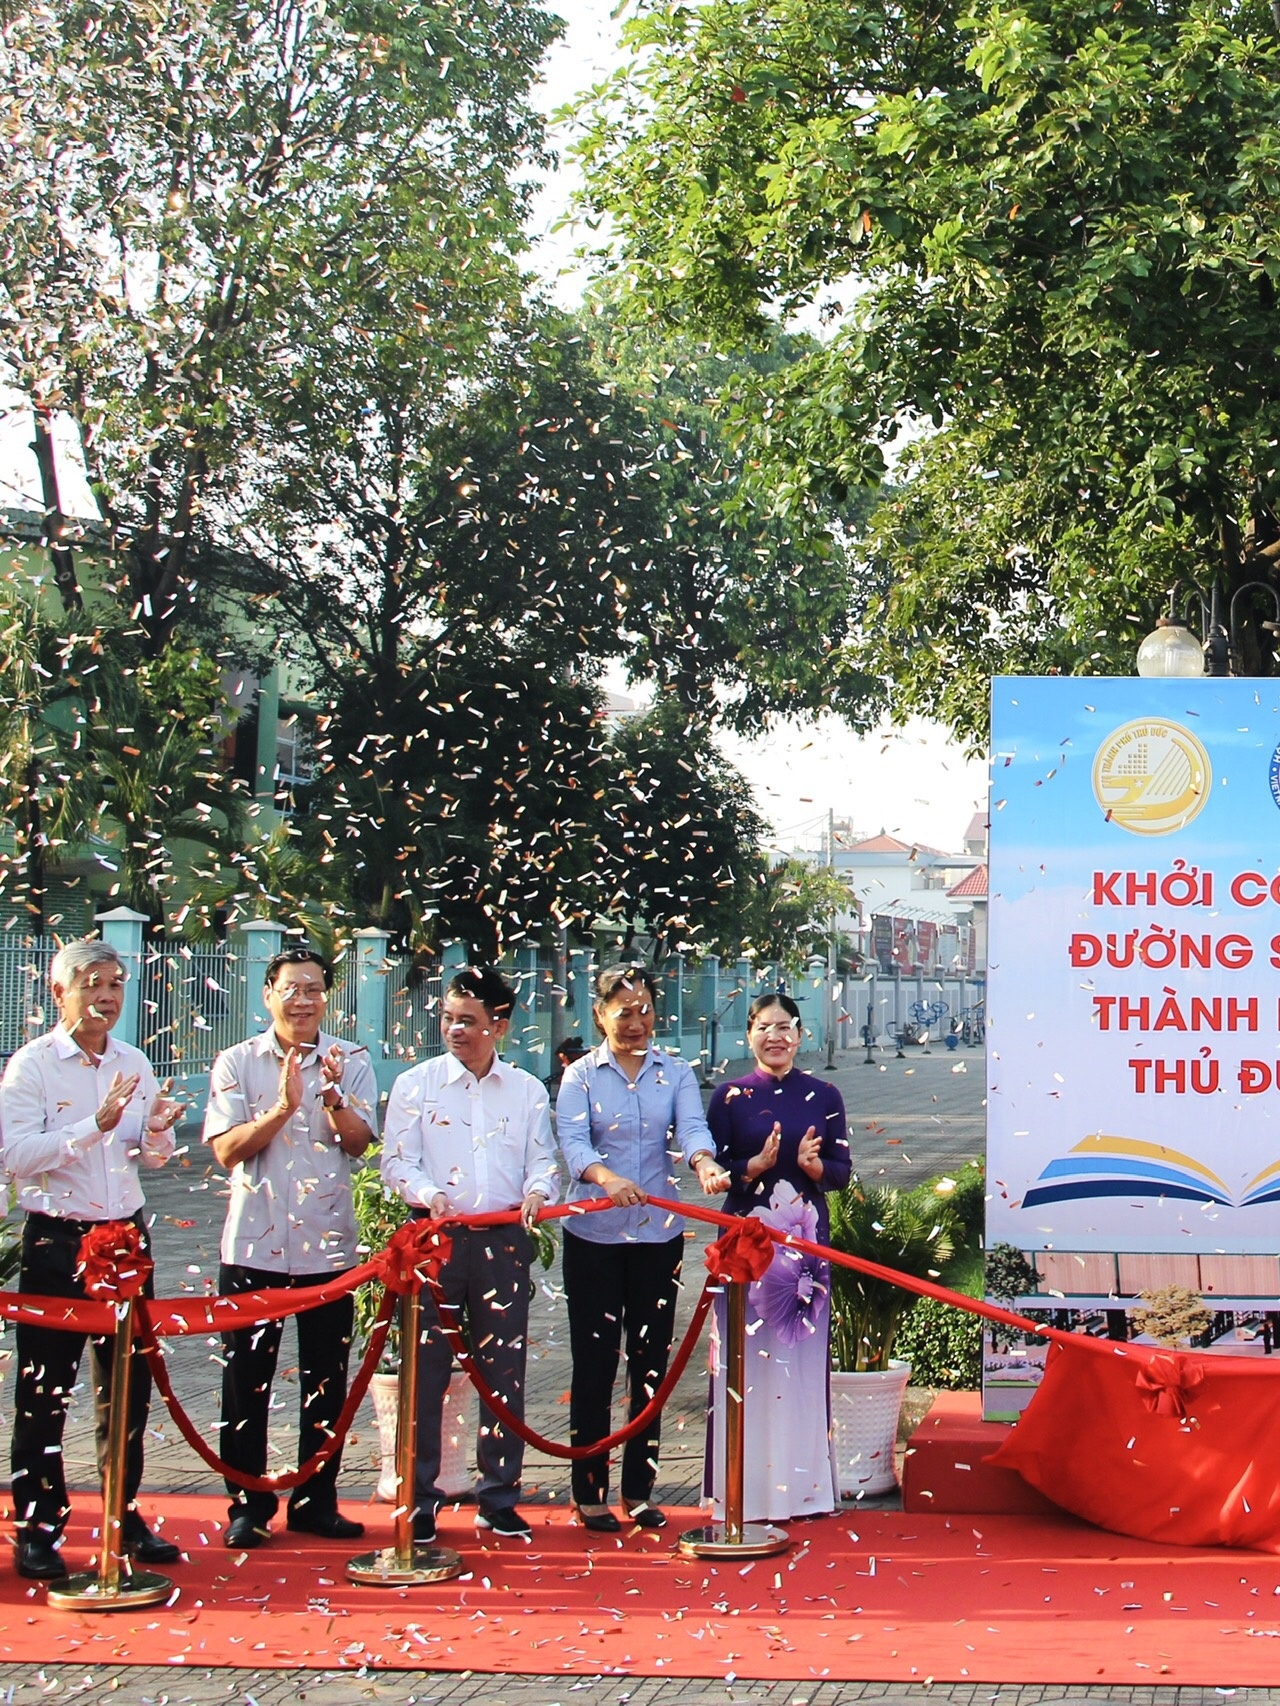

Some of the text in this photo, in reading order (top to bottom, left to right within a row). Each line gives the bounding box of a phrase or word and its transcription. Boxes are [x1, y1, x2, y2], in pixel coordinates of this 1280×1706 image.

[1093, 859, 1214, 906] KHỞI
[1068, 923, 1254, 968] ĐƯỜNG
[1093, 985, 1259, 1031] THÀNH
[1128, 1046, 1220, 1093] THỦ
